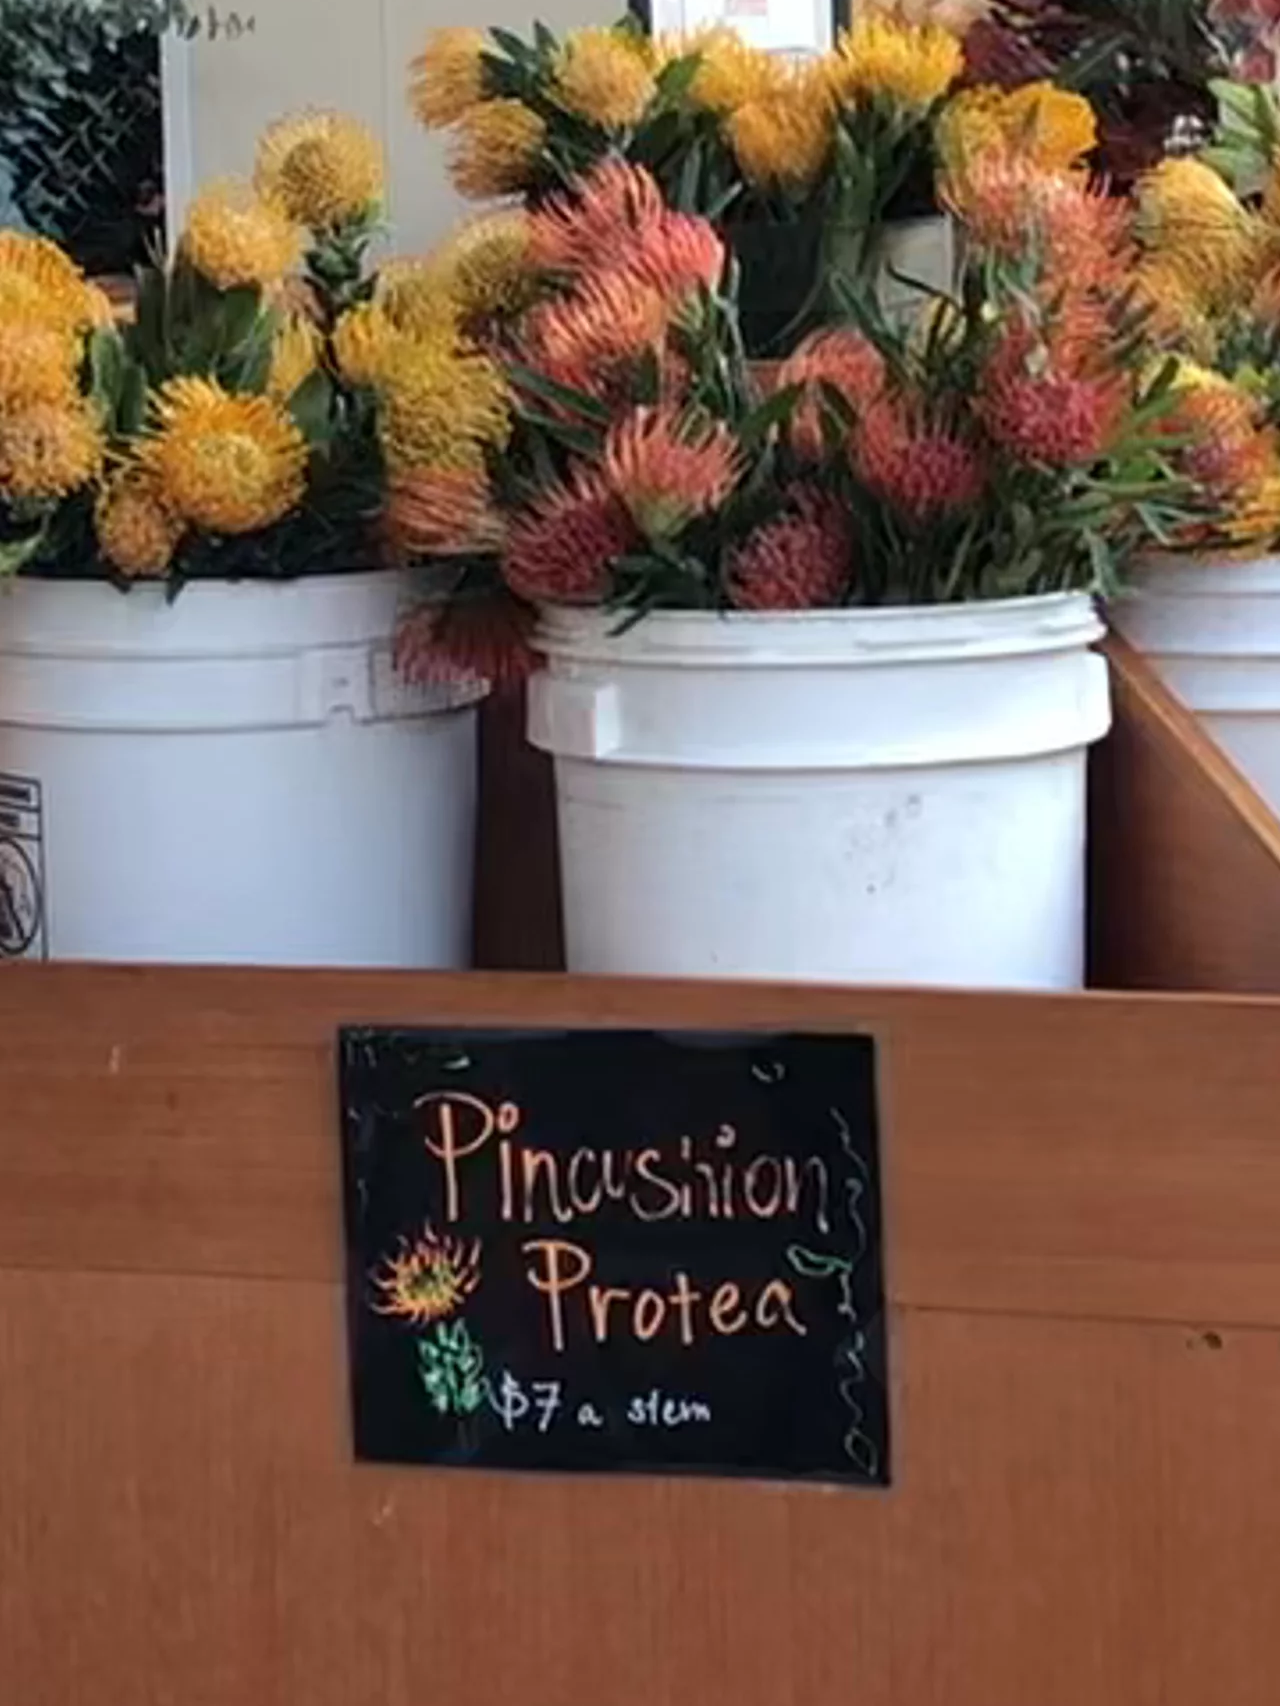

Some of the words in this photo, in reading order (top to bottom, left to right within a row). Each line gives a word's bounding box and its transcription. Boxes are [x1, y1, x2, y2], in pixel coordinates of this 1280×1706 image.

[522, 1239, 807, 1352] Protea
[486, 1370, 563, 1432] $7
[577, 1396, 604, 1427] a
[627, 1389, 712, 1425] stem
